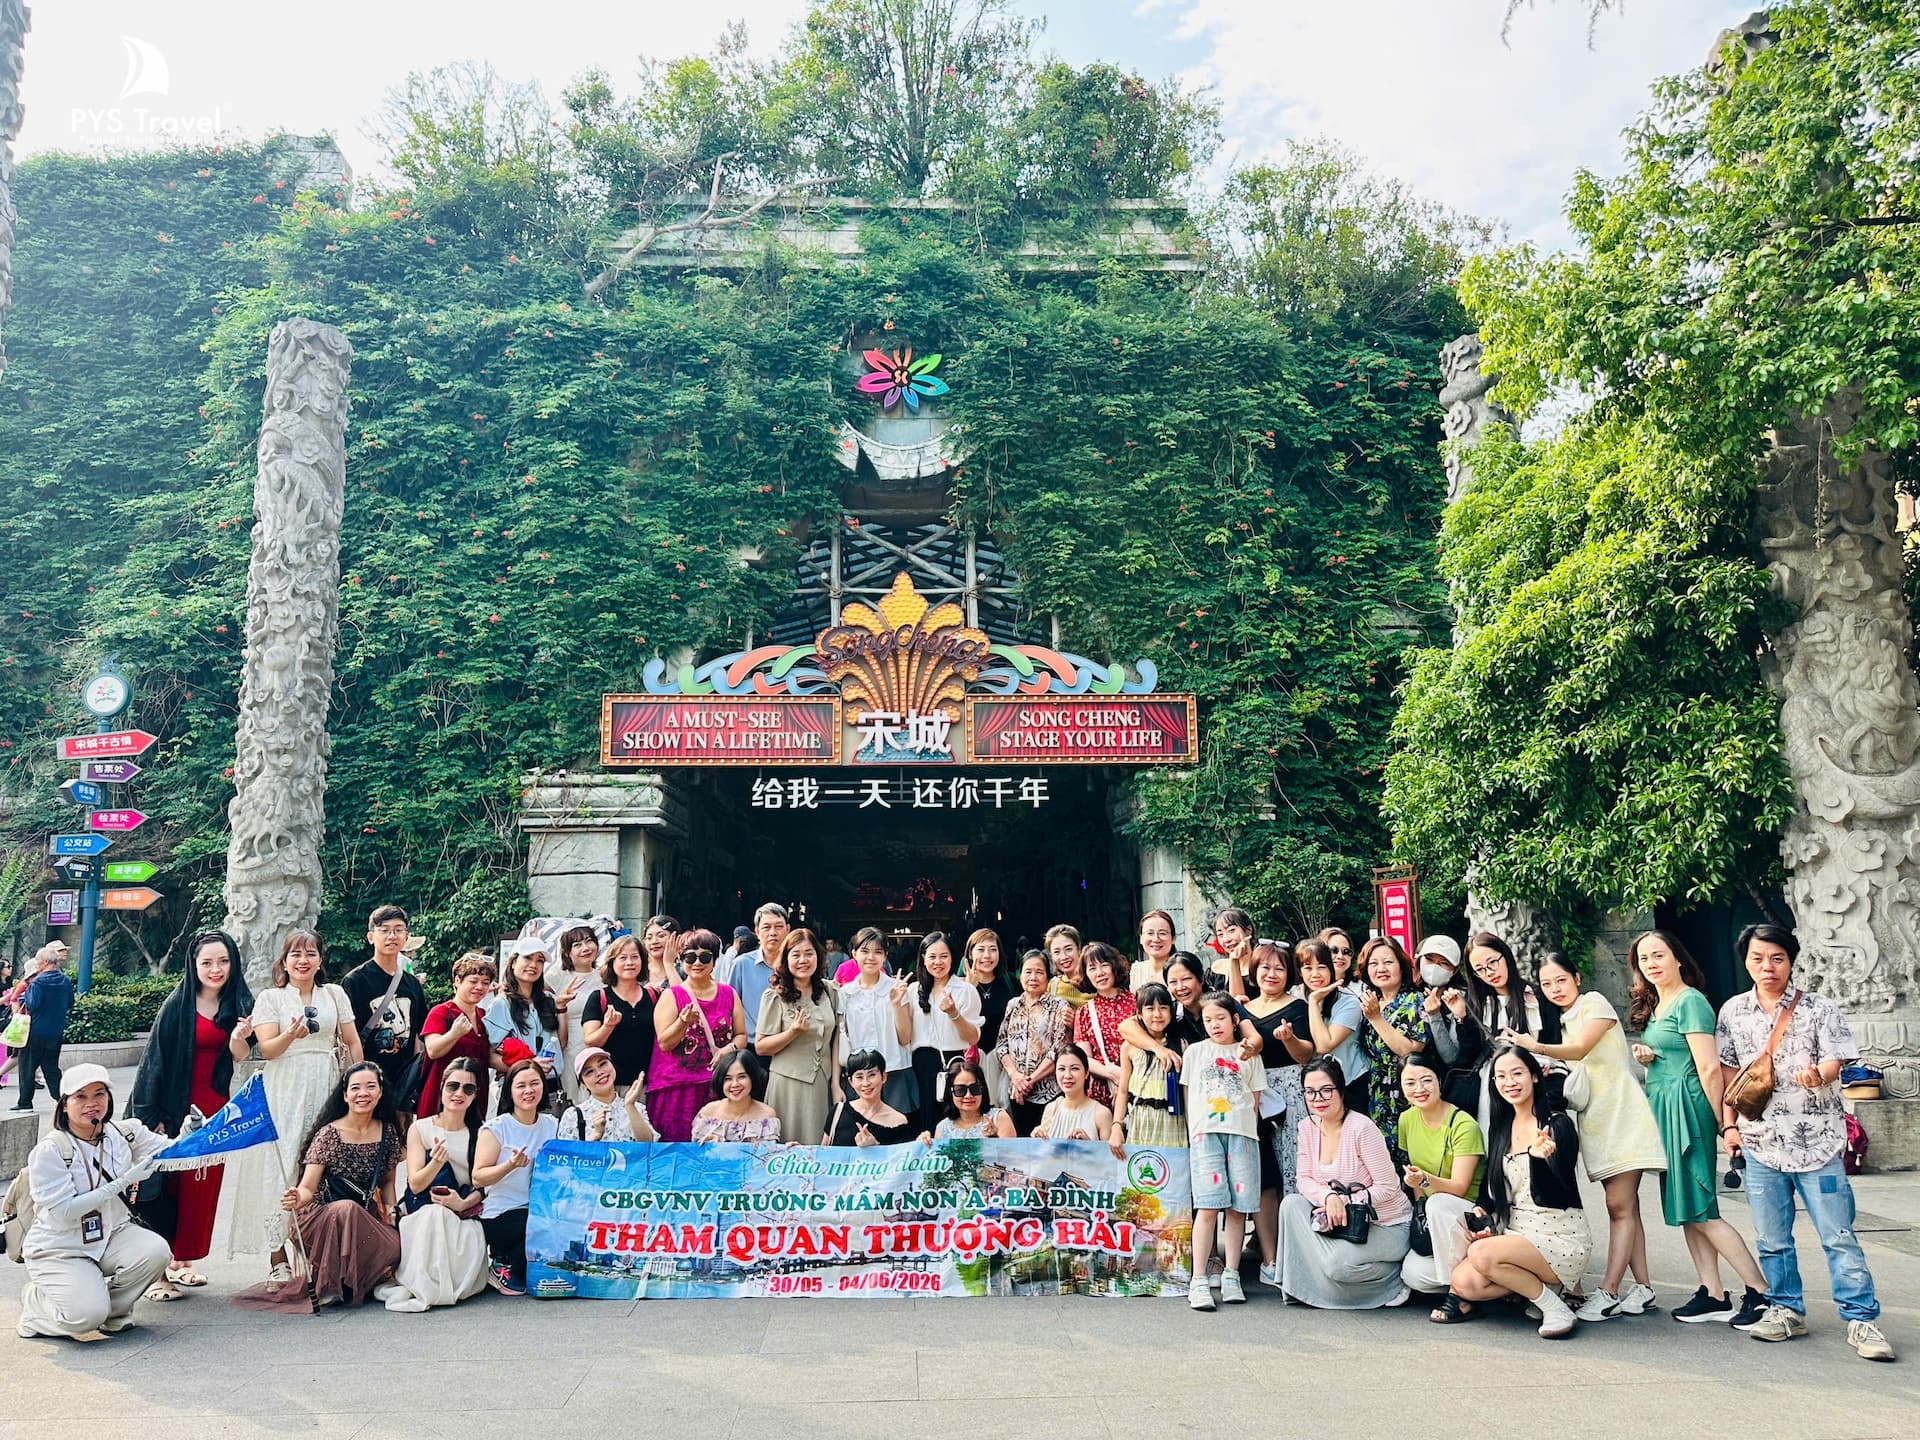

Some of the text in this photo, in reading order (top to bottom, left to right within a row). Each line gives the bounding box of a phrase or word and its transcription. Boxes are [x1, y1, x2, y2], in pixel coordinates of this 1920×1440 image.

[665, 711, 782, 729] A MUST-SEE
[1019, 710, 1141, 728] SONG CHENG
[623, 732, 822, 750] SHOW IN A LIFETIME
[856, 708, 952, 754] 宋城
[1000, 730, 1163, 748] STAGE YOUR LIFE
[751, 777, 1050, 809] 给我一天 还你千年
[208, 1129, 230, 1145] PYS
[231, 1112, 265, 1133] Travel
[548, 1154, 606, 1167] PYS Travel
[767, 1153, 822, 1175] Chào
[600, 1191, 711, 1212] CBGVNV
[717, 1190, 825, 1212] TRƯỜNG
[902, 1190, 958, 1211] NON
[967, 1189, 986, 1209] A
[1007, 1189, 1043, 1208] BA
[1050, 1187, 1116, 1210] ĐÌNH
[588, 1211, 1136, 1261] THAM QUAN THƯỢNG HẢI
[769, 1276, 823, 1293] 30/05
[839, 1272, 942, 1292] 04/06/2026
